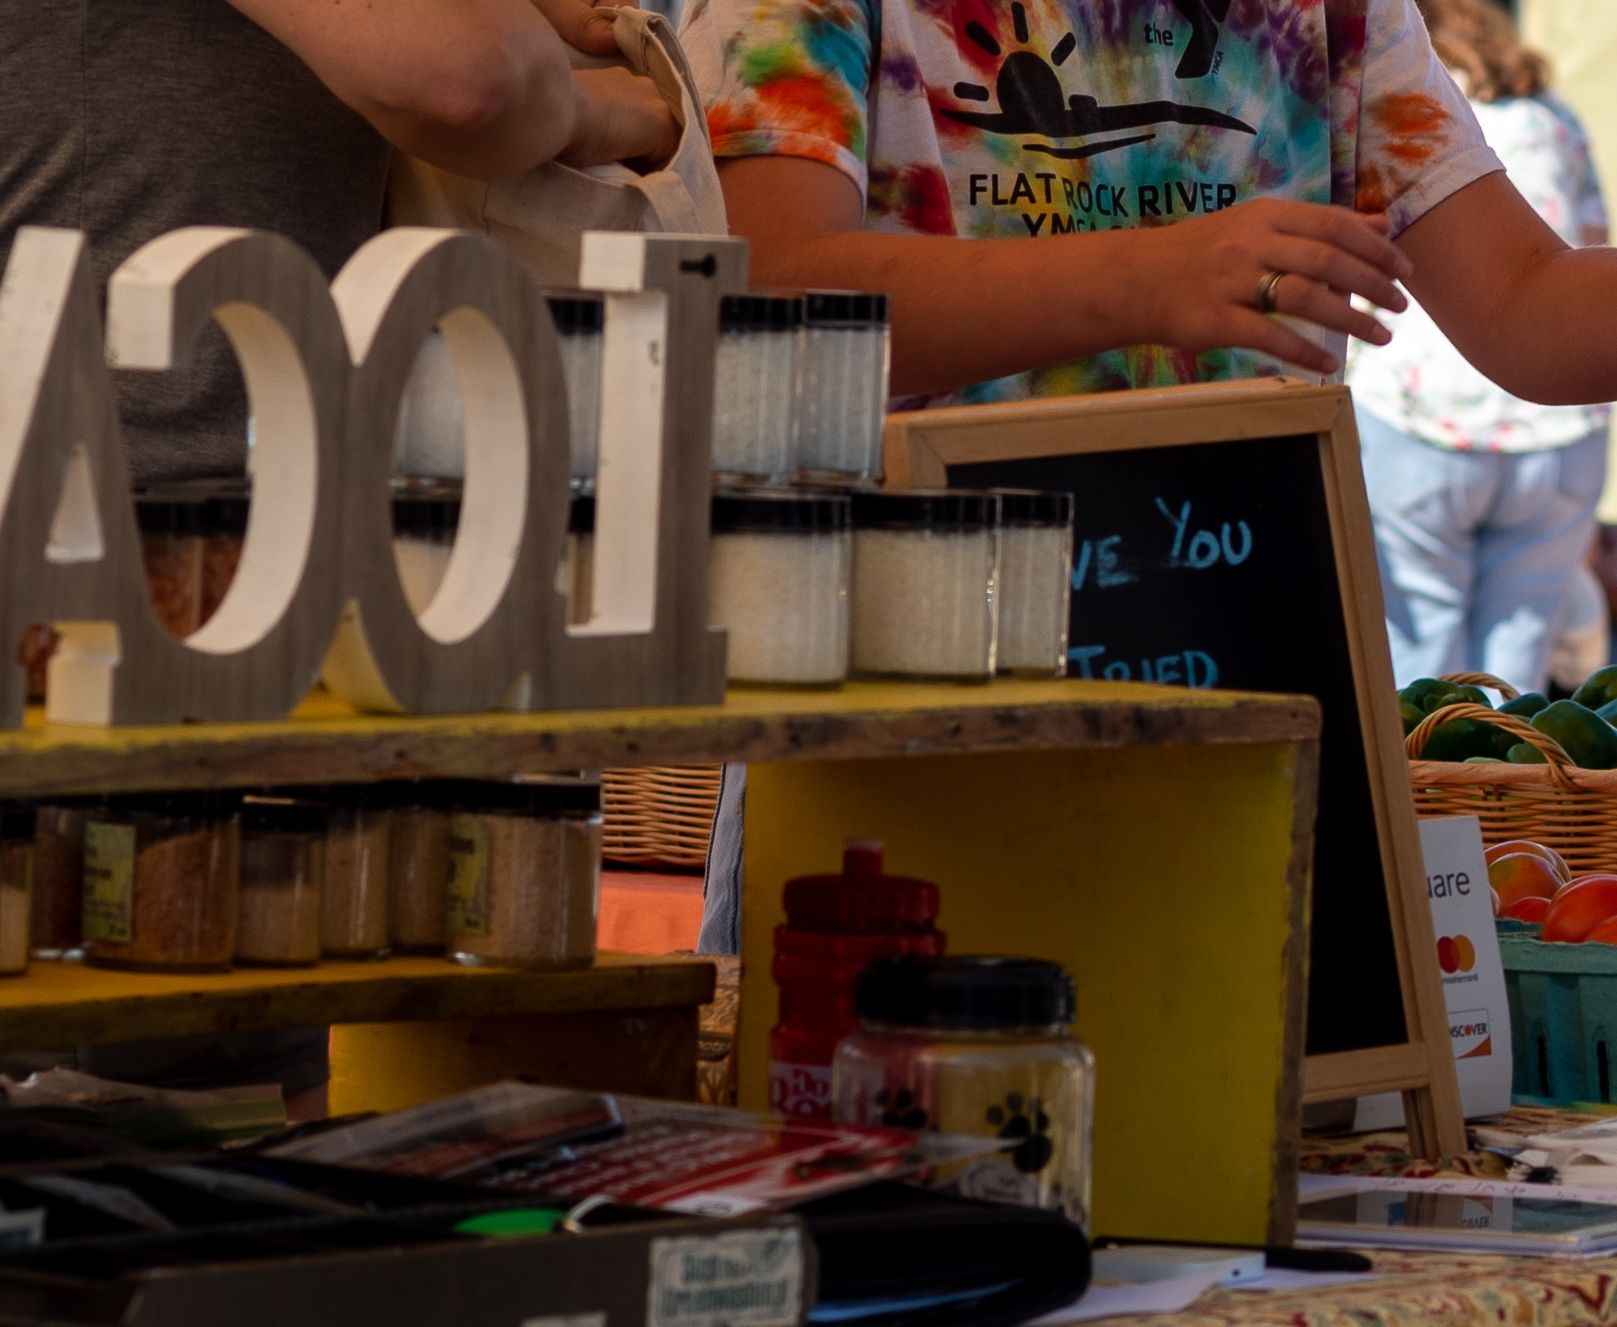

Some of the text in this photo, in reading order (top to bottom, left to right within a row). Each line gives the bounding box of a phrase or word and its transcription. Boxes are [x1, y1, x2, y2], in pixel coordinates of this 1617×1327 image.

[1144, 21, 1174, 47] the
[969, 172, 1237, 218] FLAT ROCK RIVER
[1071, 535, 1136, 590] VE
